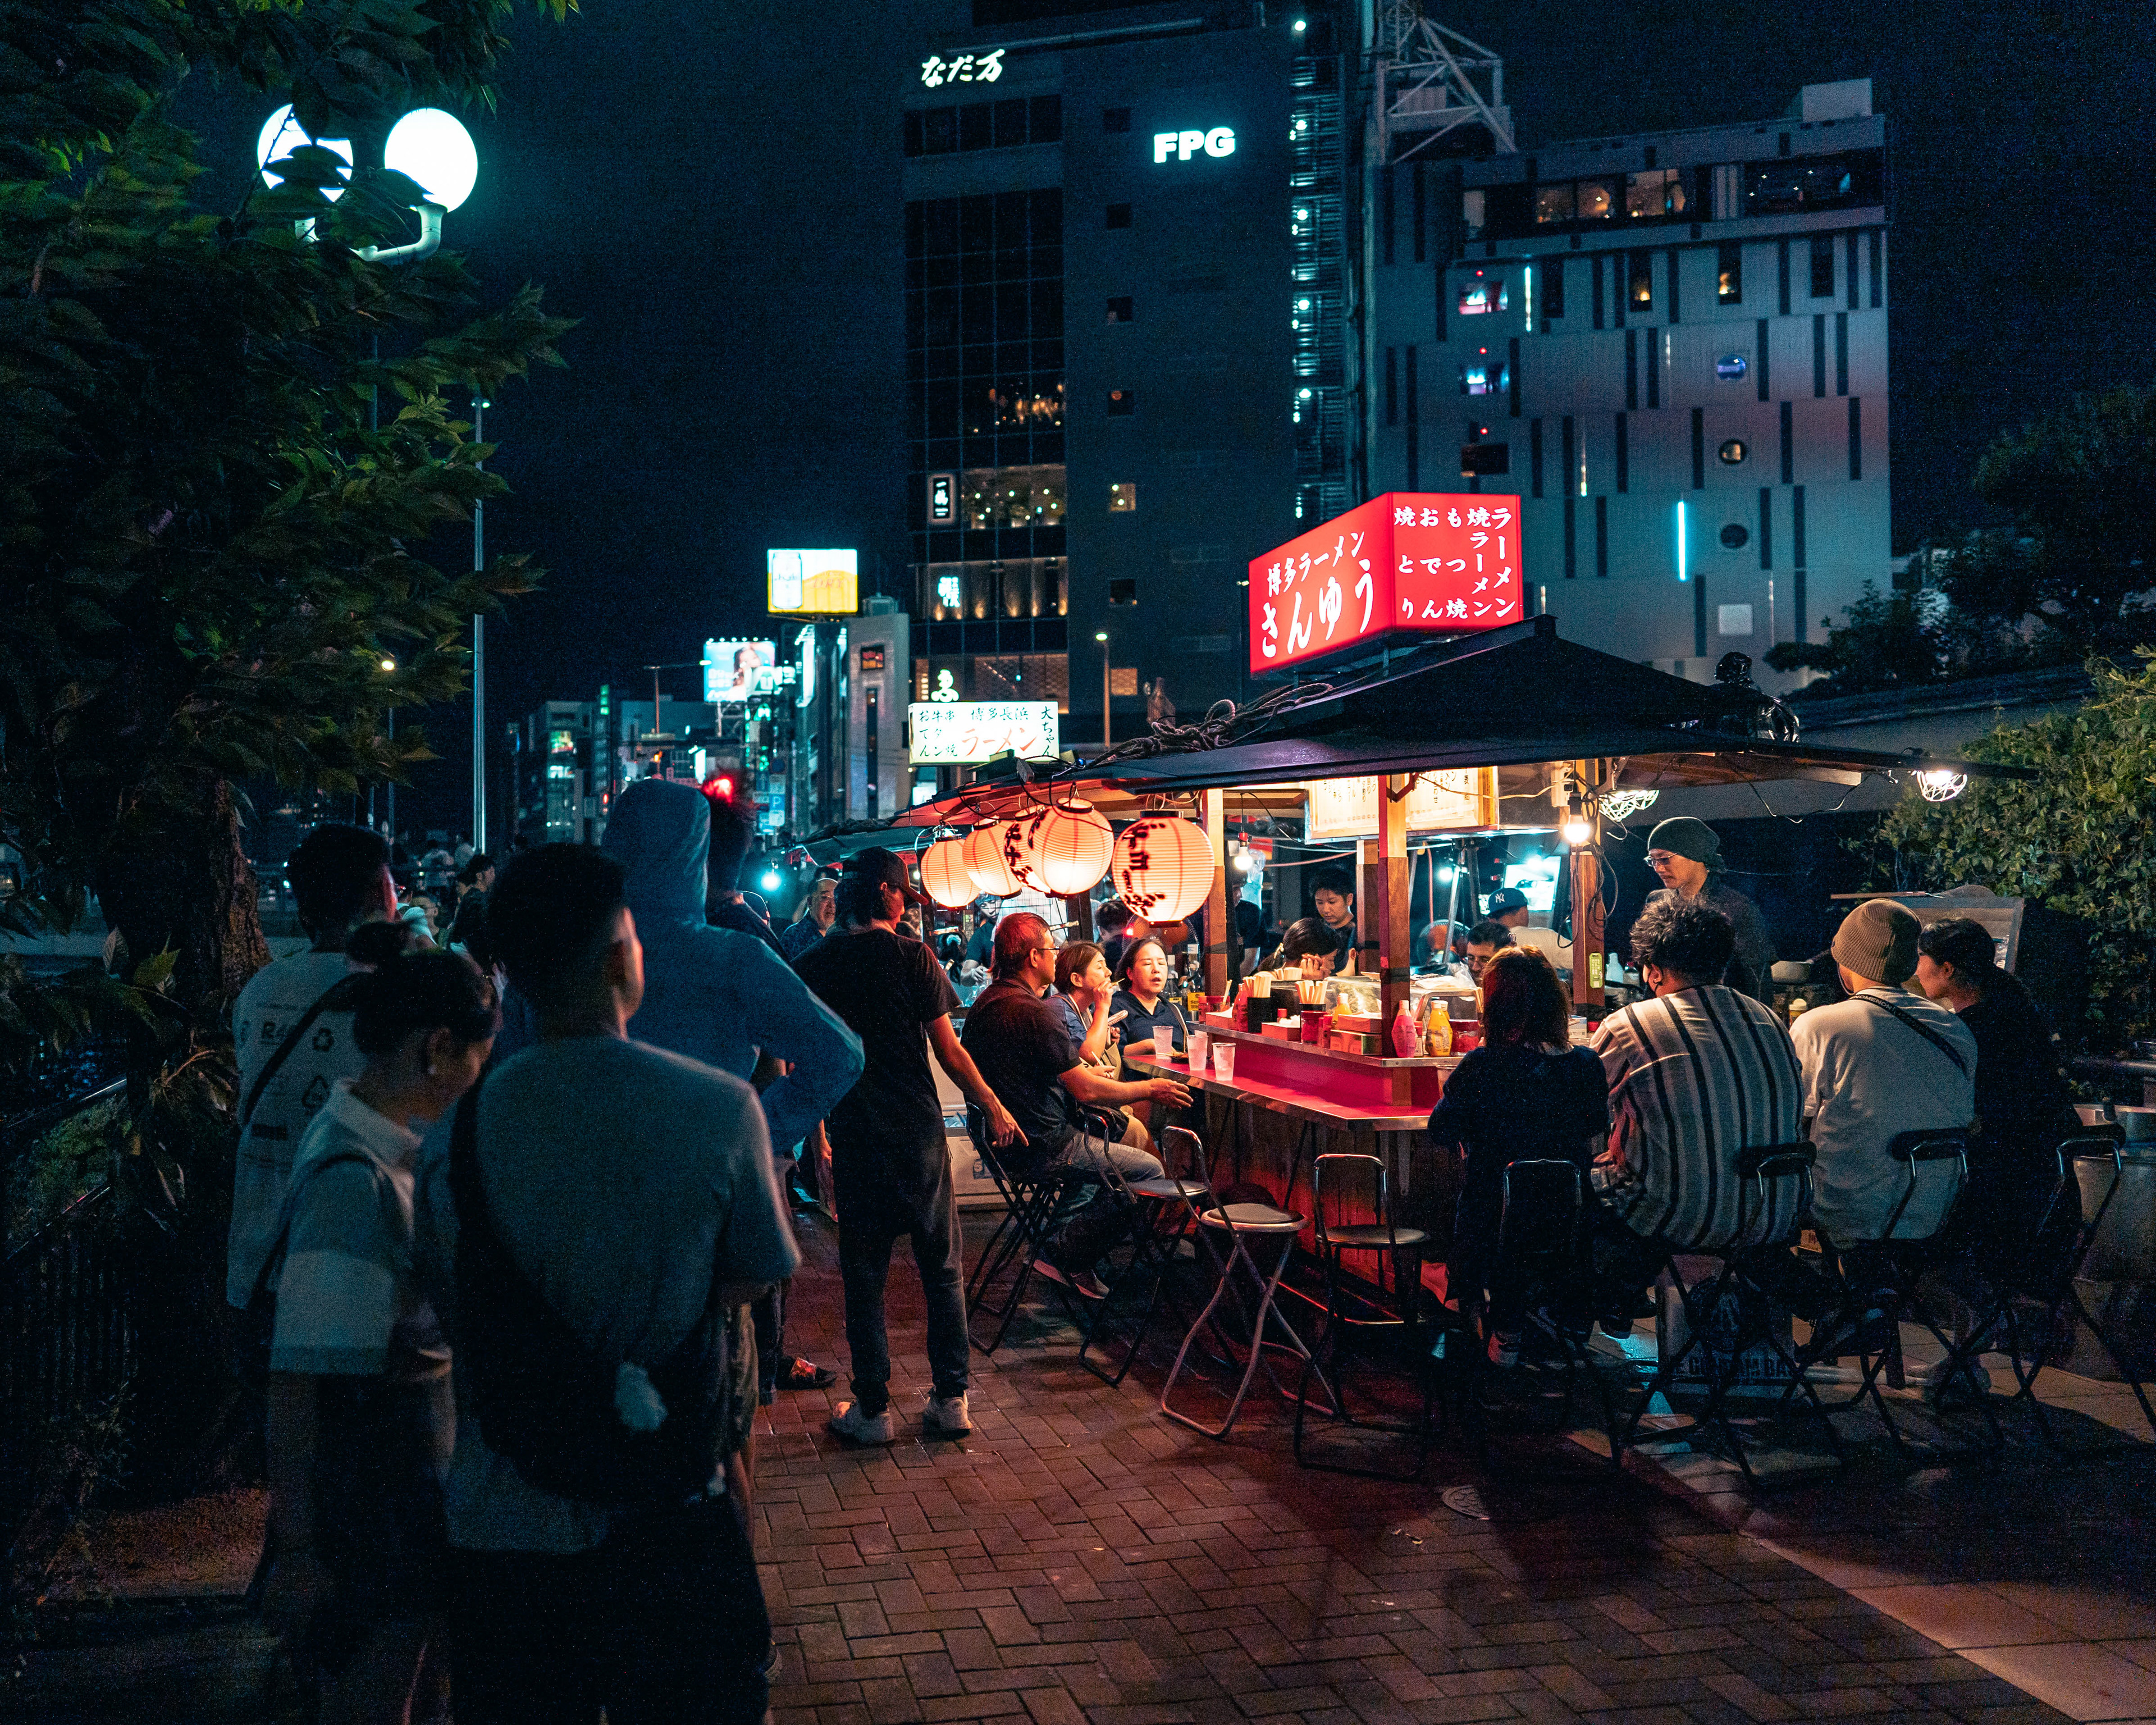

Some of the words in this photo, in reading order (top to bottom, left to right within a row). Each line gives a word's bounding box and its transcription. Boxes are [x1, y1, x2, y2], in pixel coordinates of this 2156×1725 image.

[921, 48, 1005, 87] なだ万
[1153, 127, 1236, 163] FPG
[1267, 531, 1365, 598] 博多ラーメン
[1394, 507, 1416, 619] 焼とり
[1420, 508, 1444, 619] おでん
[1446, 508, 1468, 619] もつ焼
[1467, 507, 1493, 617] 焼ラーメン
[1491, 508, 1516, 618] ラーメン
[1261, 559, 1374, 659] さんゆう
[931, 710, 943, 756] 牛タン
[945, 710, 958, 756] 串焼
[971, 706, 1029, 721] 博多長浜
[1040, 706, 1055, 756] 大ちゃん
[961, 727, 1038, 756] ラーメン
[773, 796, 781, 807] P
[1495, 893, 1505, 903] NY
